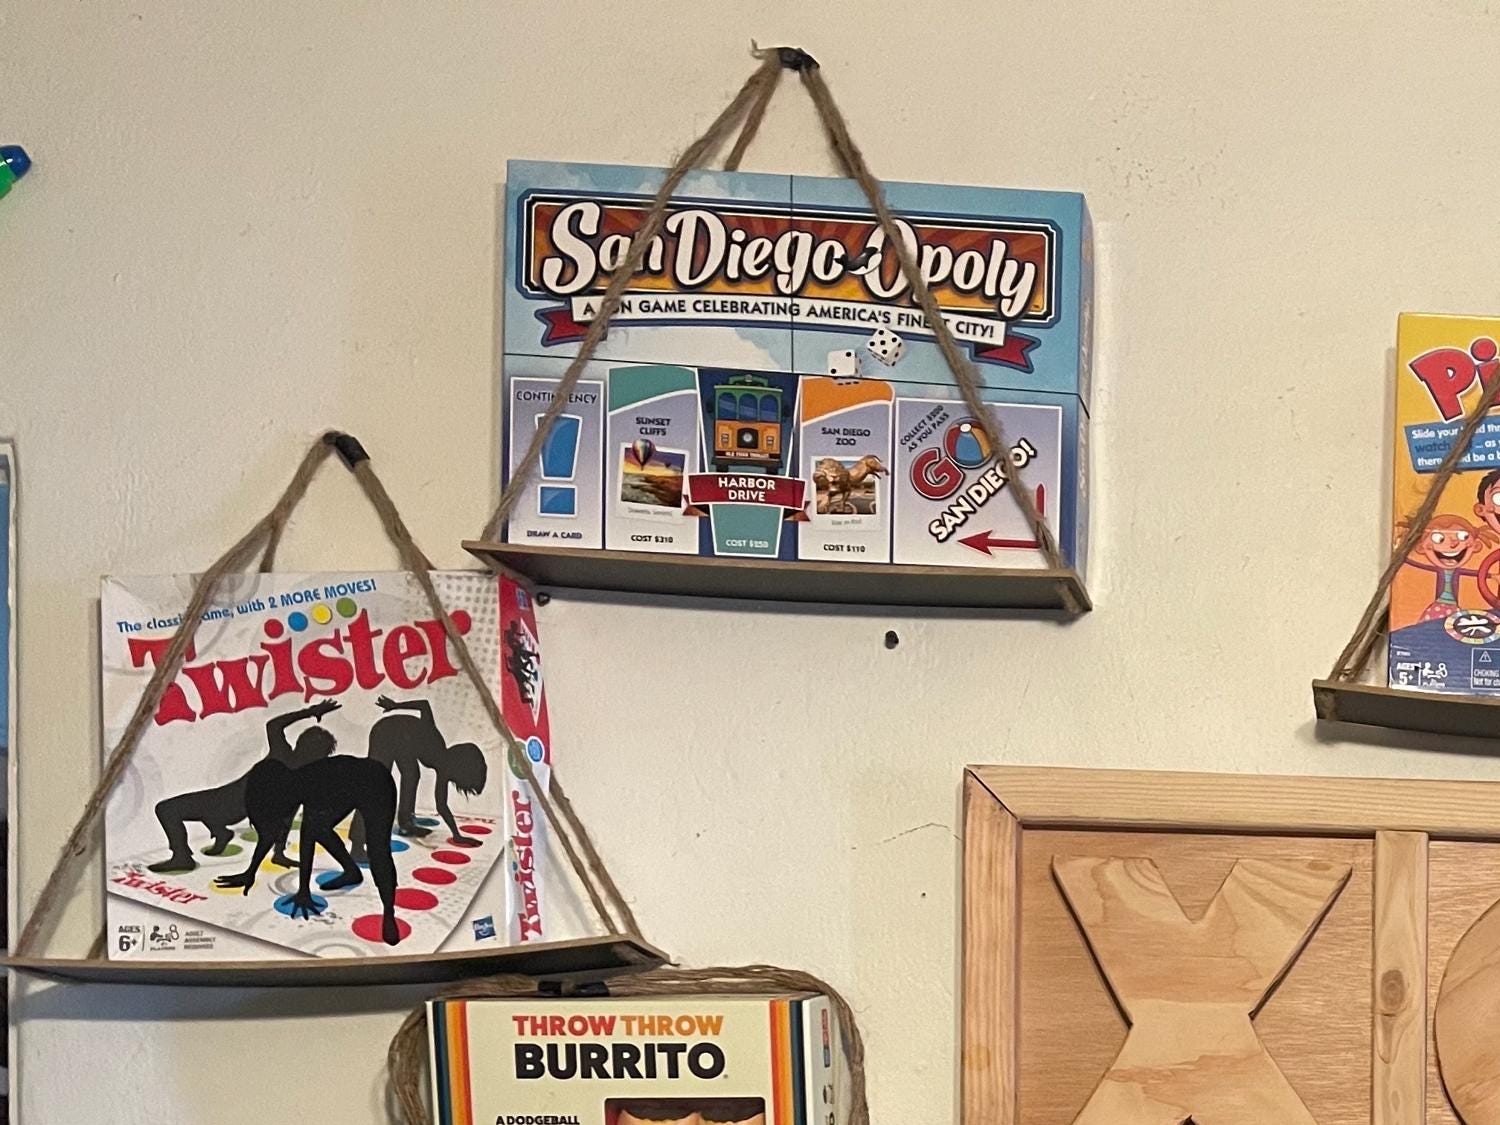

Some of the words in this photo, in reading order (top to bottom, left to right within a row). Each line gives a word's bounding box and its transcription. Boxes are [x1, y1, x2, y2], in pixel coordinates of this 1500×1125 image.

[639, 300, 687, 313] GAME
[692, 300, 801, 317] CELEBRATING
[806, 304, 891, 323] AMERICA'S
[897, 312, 950, 330] FINET
[955, 321, 994, 338] CITY!
[635, 416, 671, 427] SUNSET
[917, 427, 933, 444] YOU
[932, 412, 949, 430] PASS
[639, 426, 667, 437] CLIFFS
[821, 426, 840, 436] SAN
[842, 427, 871, 437] DIEGO
[900, 418, 927, 446] COLLECT
[1411, 428, 1435, 440] Slide
[1437, 428, 1459, 441] your
[835, 437, 857, 446] ZOO
[1415, 441, 1450, 454] watch
[1485, 438, 1496, 448] as
[1417, 456, 1442, 467] there
[1473, 452, 1486, 462] be
[718, 477, 776, 490] HARBOR
[728, 490, 766, 502] DRIVE
[928, 495, 977, 544] SAN
[526, 530, 550, 539] DRAW
[560, 531, 582, 540] CARD
[630, 534, 652, 544] COST
[725, 538, 747, 548] COST
[823, 543, 844, 552] COST
[116, 619, 142, 633] The
[146, 613, 183, 630] classi
[236, 599, 265, 615] with
[268, 596, 277, 609] 2
[280, 588, 321, 607] MORE
[324, 578, 377, 599] MOVES!
[127, 608, 472, 727] Twister
[118, 925, 141, 934] AGES
[118, 935, 138, 952] 6+
[512, 1015, 617, 1036] THROW
[619, 1015, 724, 1036] THROW
[514, 1042, 726, 1080] BURRITO
[496, 1115, 505, 1125] A
[506, 1115, 580, 1125] DODGEBALL
